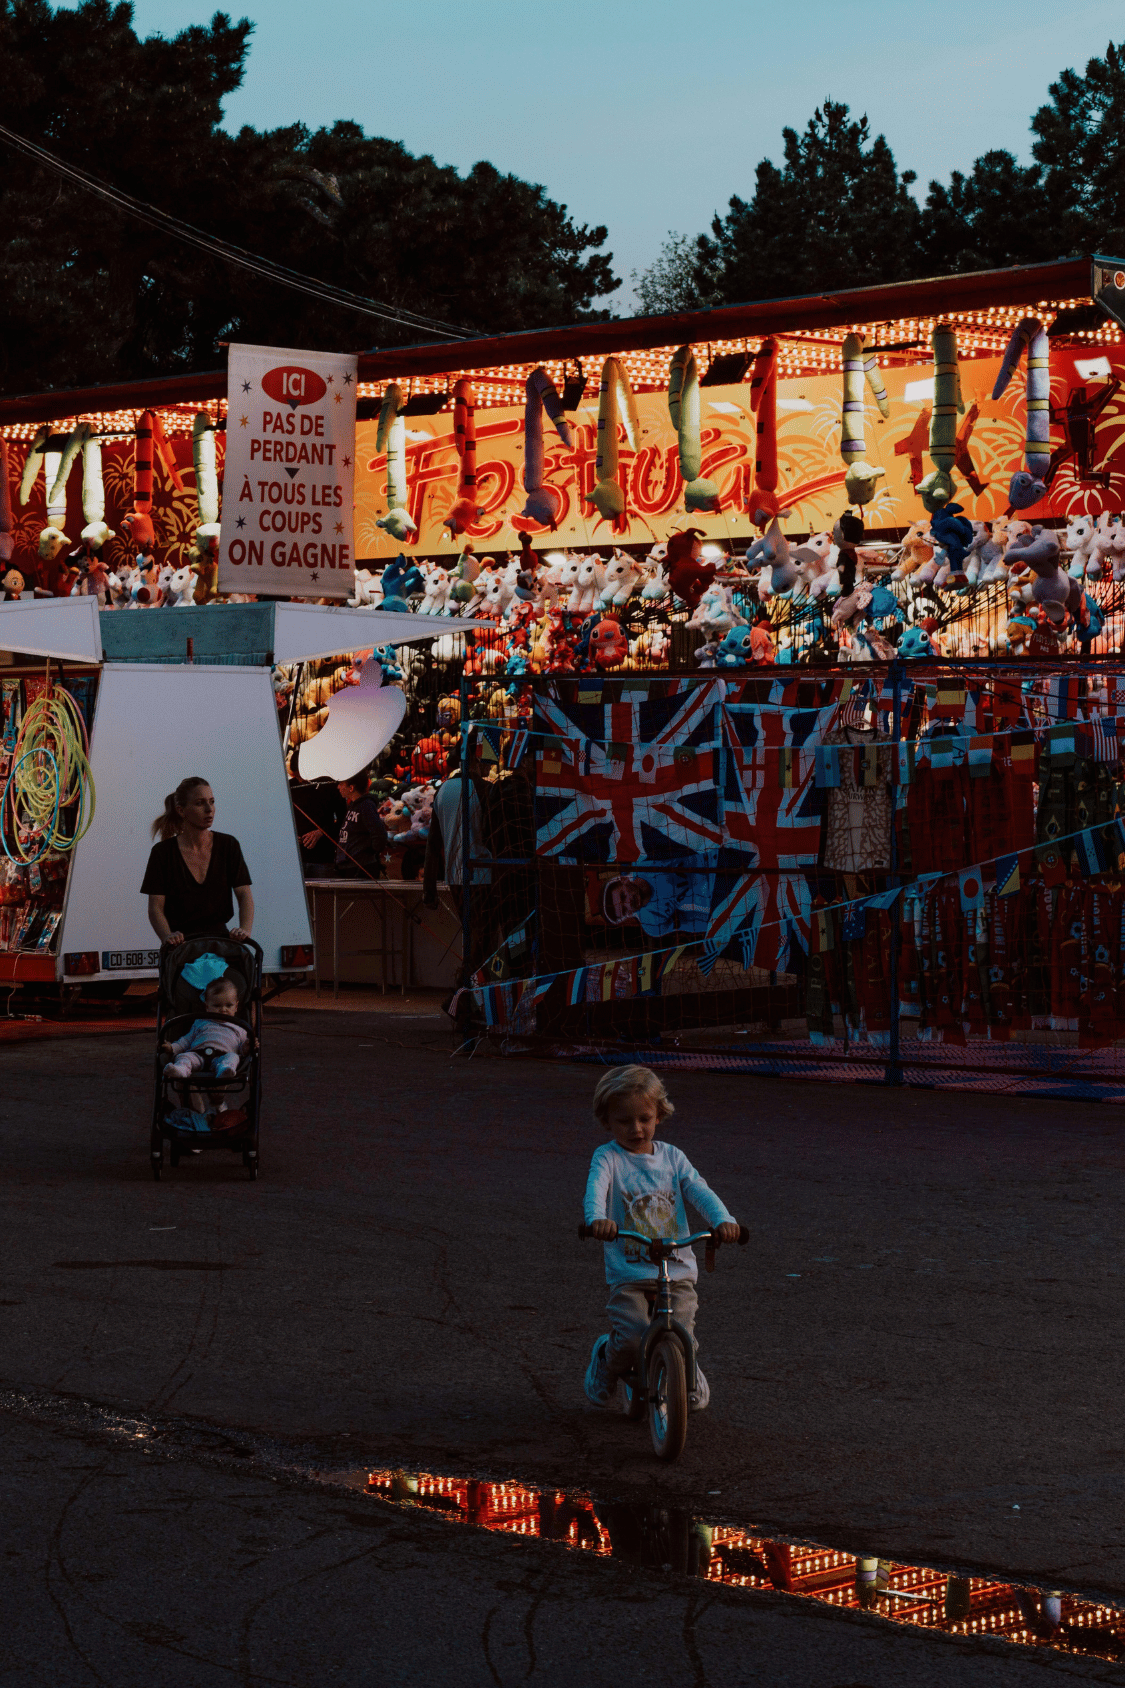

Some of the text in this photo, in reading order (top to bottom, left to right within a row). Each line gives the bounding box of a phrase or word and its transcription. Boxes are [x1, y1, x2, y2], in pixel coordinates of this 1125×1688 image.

[282, 372, 306, 397] ICI
[262, 410, 325, 437] PAS DE
[250, 438, 337, 466] PERDANT
[238, 474, 343, 508] À TOUS LES
[258, 509, 323, 535] COUPS
[228, 538, 351, 570] ON GAGNE
